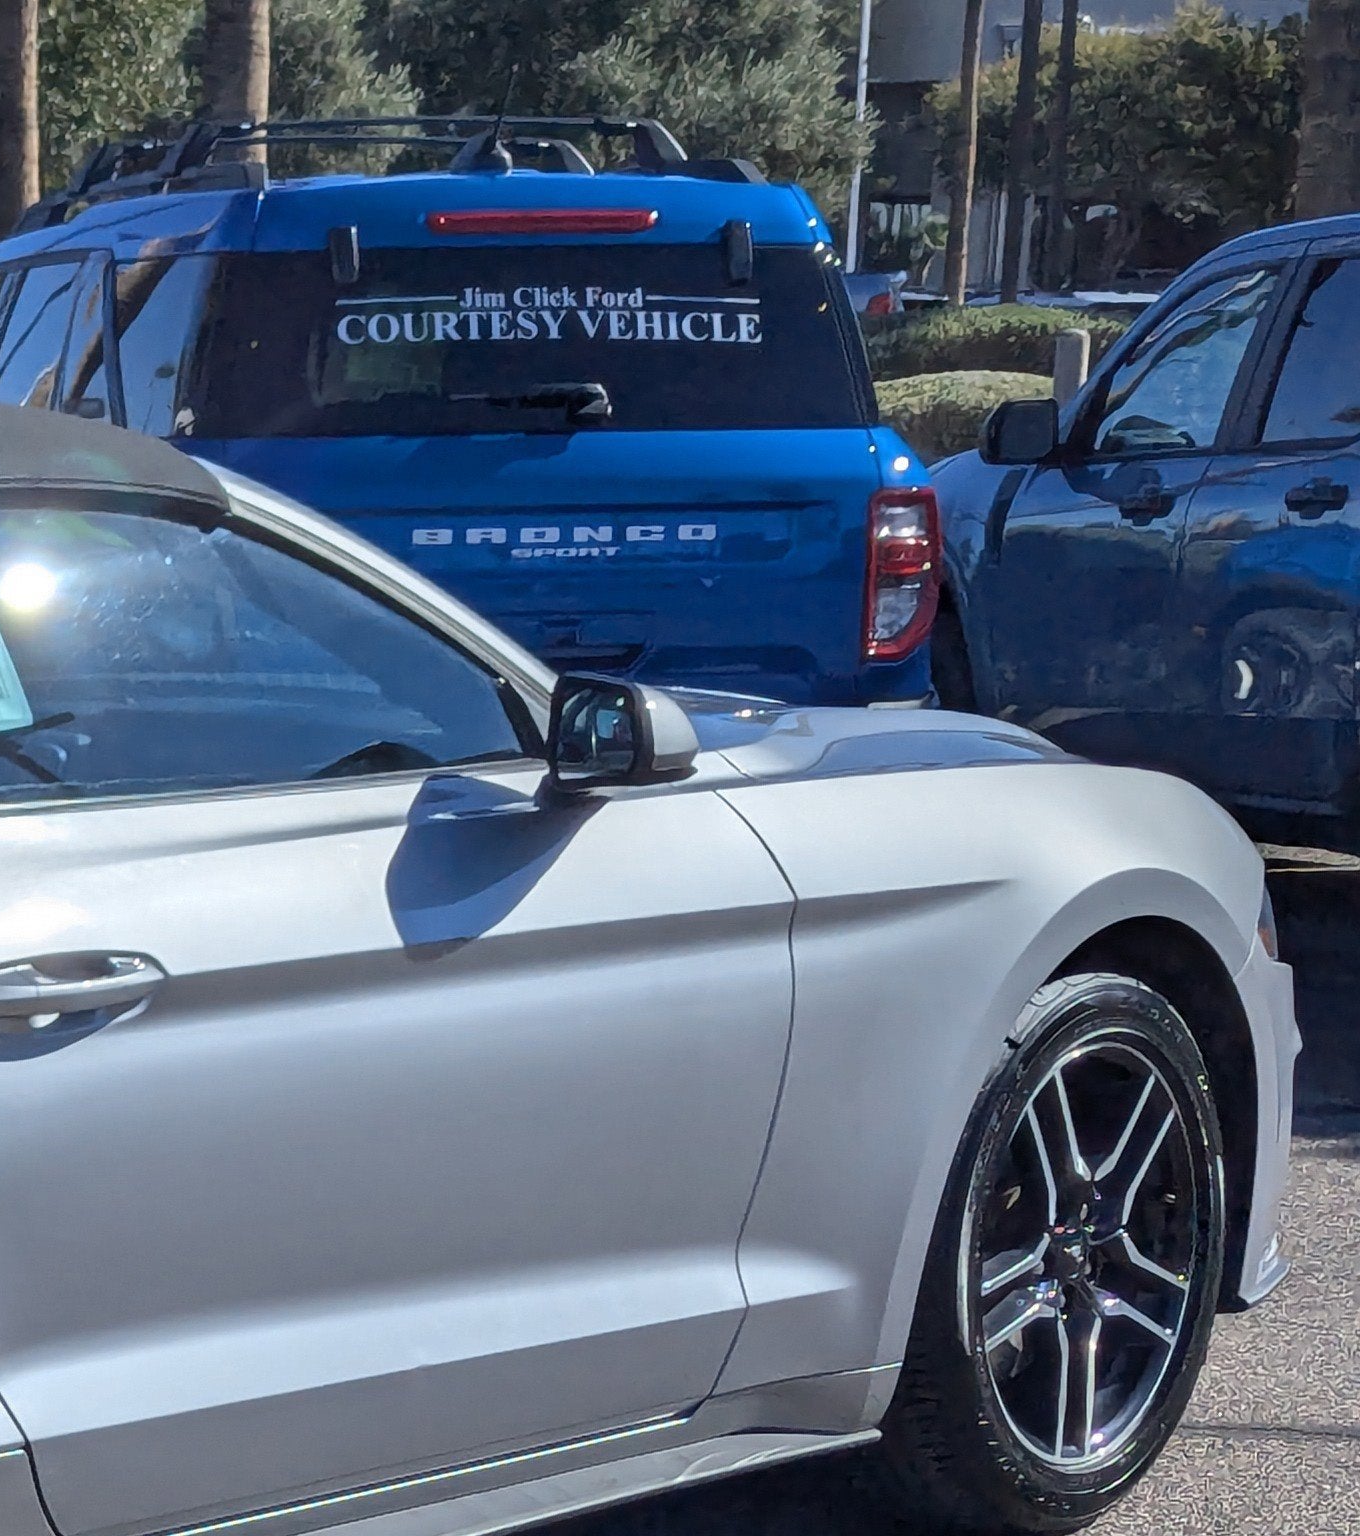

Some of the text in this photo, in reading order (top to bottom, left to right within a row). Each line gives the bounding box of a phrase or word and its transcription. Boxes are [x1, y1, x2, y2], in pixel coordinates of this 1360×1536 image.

[459, 286, 644, 308] Jim Click Ford
[337, 309, 763, 345] COURTESY VEHICLE
[411, 523, 717, 546] BRONCO
[510, 546, 621, 559] SPORT
